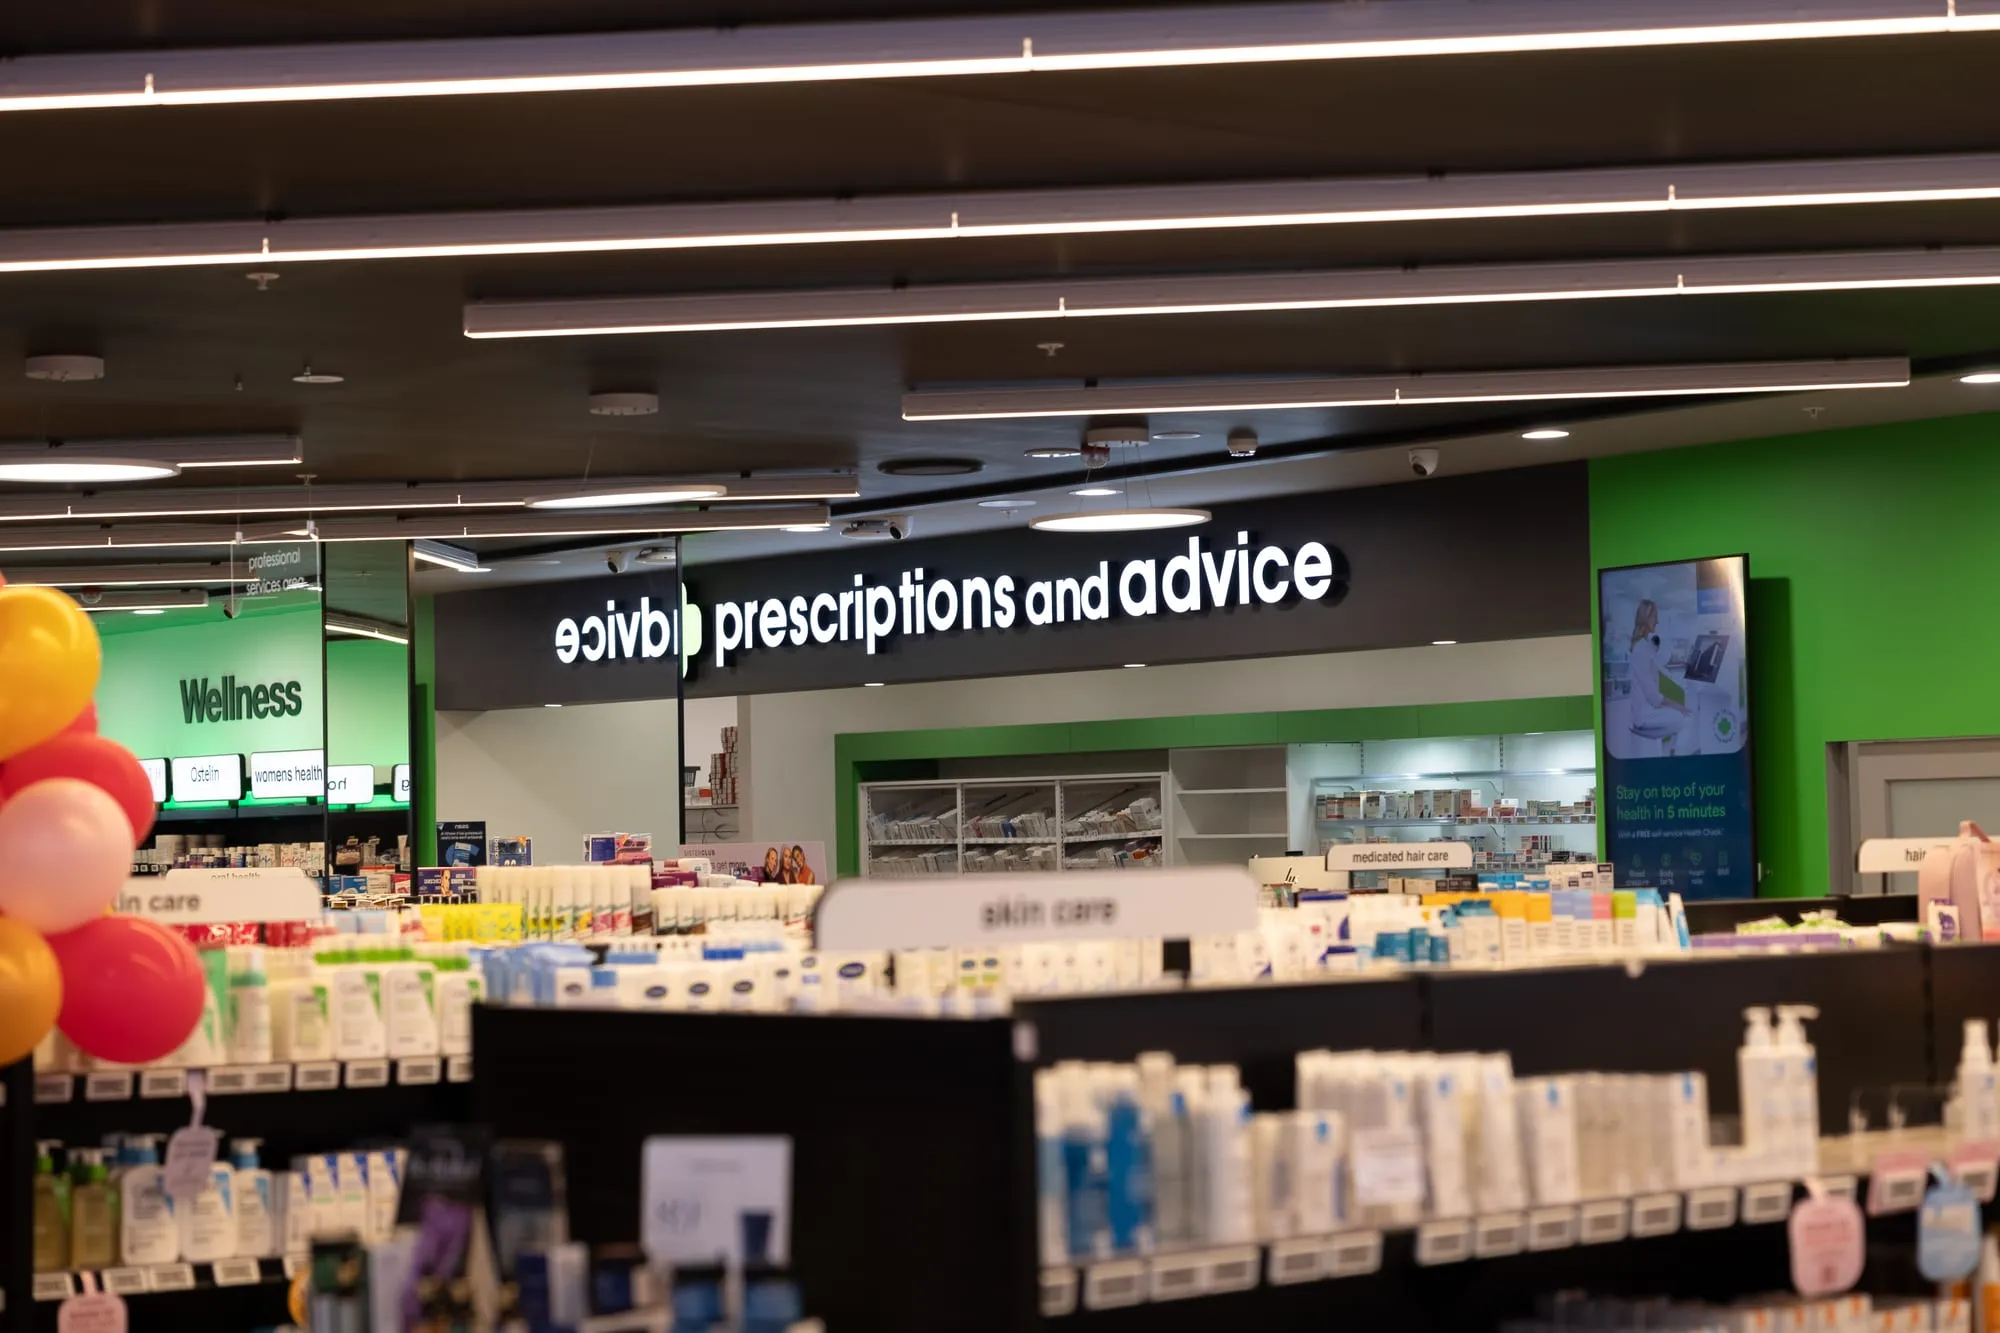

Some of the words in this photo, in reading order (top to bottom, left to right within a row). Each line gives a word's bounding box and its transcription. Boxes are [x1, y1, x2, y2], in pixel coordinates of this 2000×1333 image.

[248, 546, 301, 573] professional
[246, 577, 281, 597] services
[714, 567, 1016, 667] prescriptions
[1026, 561, 1109, 625] and
[1119, 531, 1333, 617] advice
[179, 676, 302, 724] Wellness
[190, 765, 220, 783] Ostelin
[254, 768, 293, 783] womens
[295, 765, 323, 782] health
[1616, 785, 1640, 802] Stay
[1643, 787, 1658, 799] on
[1661, 785, 1681, 800] top
[1683, 782, 1697, 797] of
[1699, 784, 1725, 800] your
[1616, 805, 1651, 820] health
[1654, 804, 1664, 819] in
[1667, 805, 1675, 819] 5
[1677, 803, 1726, 819] minutes
[1352, 850, 1404, 864] medicated
[1406, 850, 1425, 862] hair
[1427, 851, 1449, 862] care
[1905, 848, 1927, 862] hair
[118, 890, 141, 912] in
[148, 893, 201, 912] care
[981, 894, 1046, 931] skin
[1051, 896, 1118, 927] care
